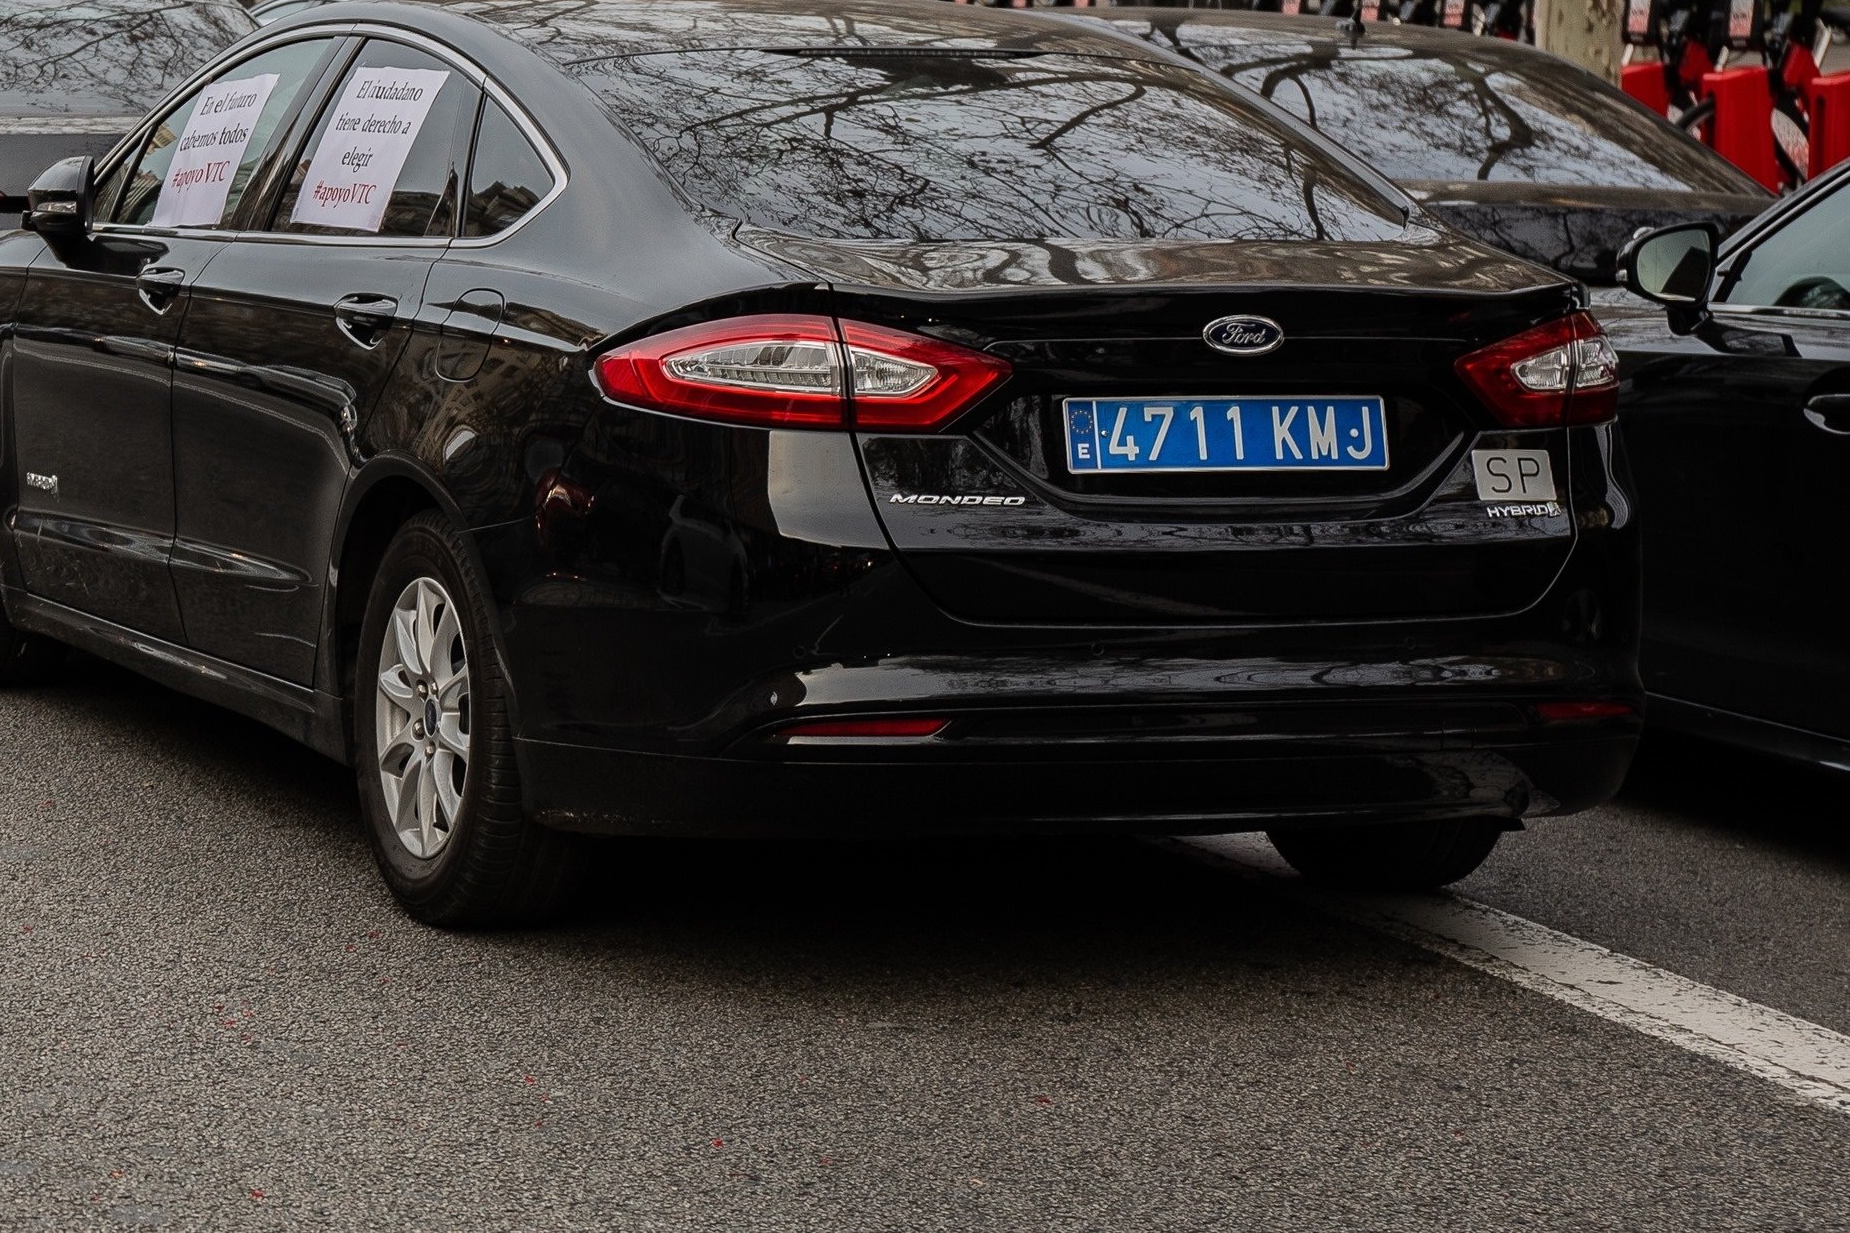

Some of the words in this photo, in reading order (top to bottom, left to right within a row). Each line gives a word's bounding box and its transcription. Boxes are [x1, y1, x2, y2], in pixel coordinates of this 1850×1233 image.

[356, 80, 372, 99] El
[369, 80, 424, 101] ciudadano
[200, 96, 214, 116] En
[214, 92, 229, 113] el
[224, 90, 258, 112] futuro
[335, 112, 361, 132] tiene
[361, 113, 402, 134] derecho
[401, 120, 412, 135] a
[179, 129, 219, 151] cabemos
[218, 122, 249, 146] todos
[341, 146, 373, 173] elegir
[312, 180, 377, 208] #apoyoVTC
[1222, 322, 1267, 345] Ford
[1108, 406, 1245, 461] 4711
[1271, 406, 1373, 460] KMJ
[1077, 443, 1090, 459] E
[1486, 456, 1540, 494] SP
[889, 493, 1026, 506] MONDEO
[1486, 504, 1548, 518] HYBRID
